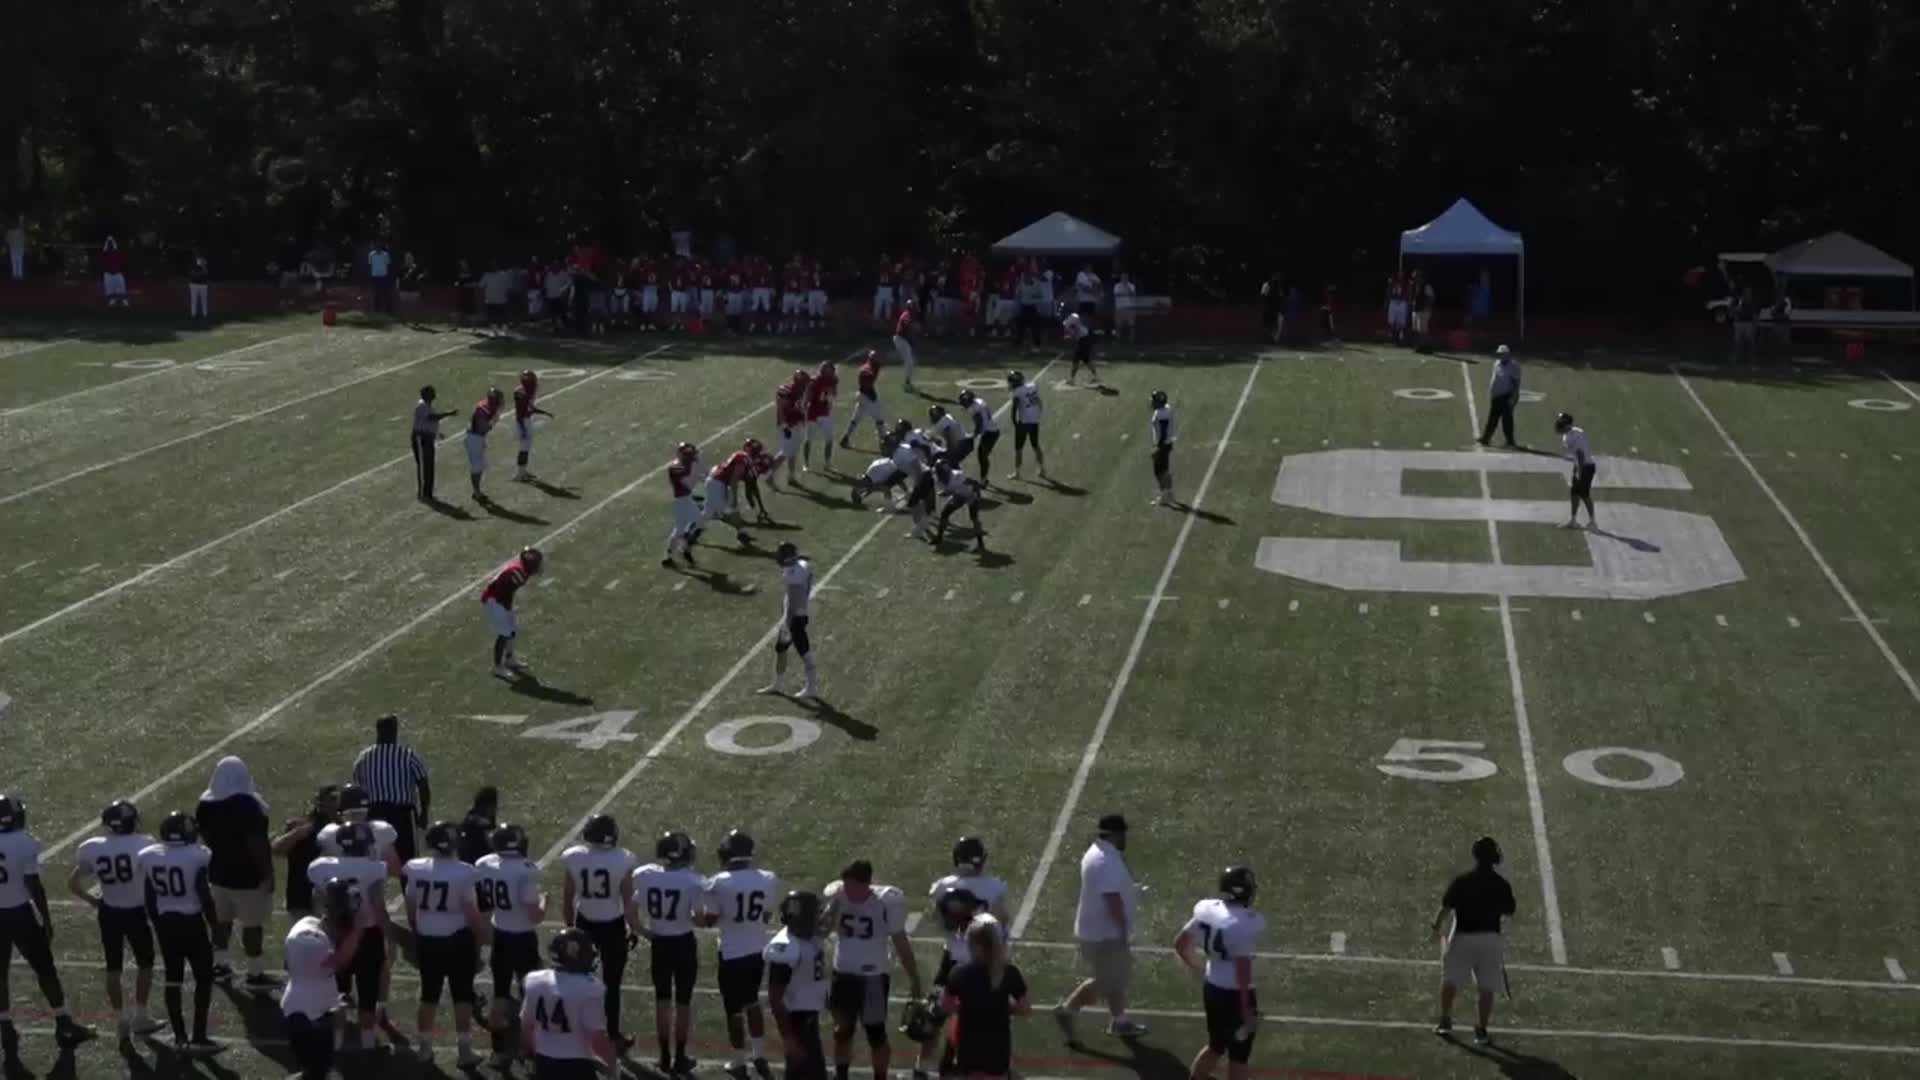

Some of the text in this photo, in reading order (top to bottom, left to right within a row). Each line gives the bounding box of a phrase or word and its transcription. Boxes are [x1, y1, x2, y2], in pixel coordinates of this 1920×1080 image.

[95, 854, 133, 884] 28
[151, 866, 185, 897] 50
[581, 869, 610, 898] 13
[415, 881, 450, 912] 77
[647, 888, 682, 921] 87
[733, 891, 766, 923] 16
[840, 914, 874, 939] 53
[1199, 921, 1228, 961] 74
[536, 995, 571, 1033] 44
